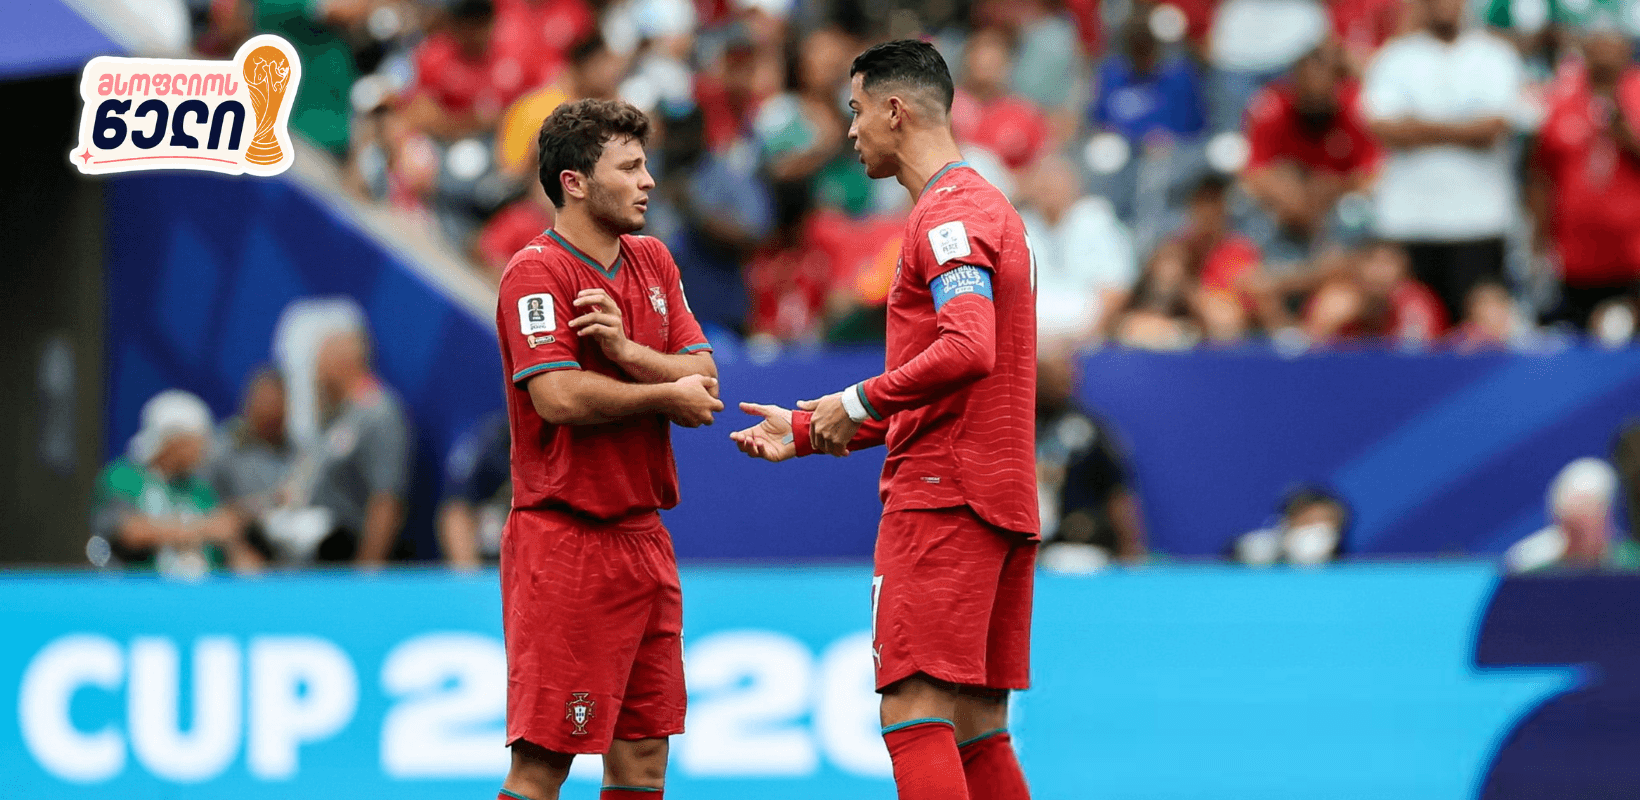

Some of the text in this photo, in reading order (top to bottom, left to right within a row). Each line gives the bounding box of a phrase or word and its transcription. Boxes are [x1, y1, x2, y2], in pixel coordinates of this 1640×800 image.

[941, 271, 981, 286] UNITES
[20, 631, 893, 782] CUP 22
